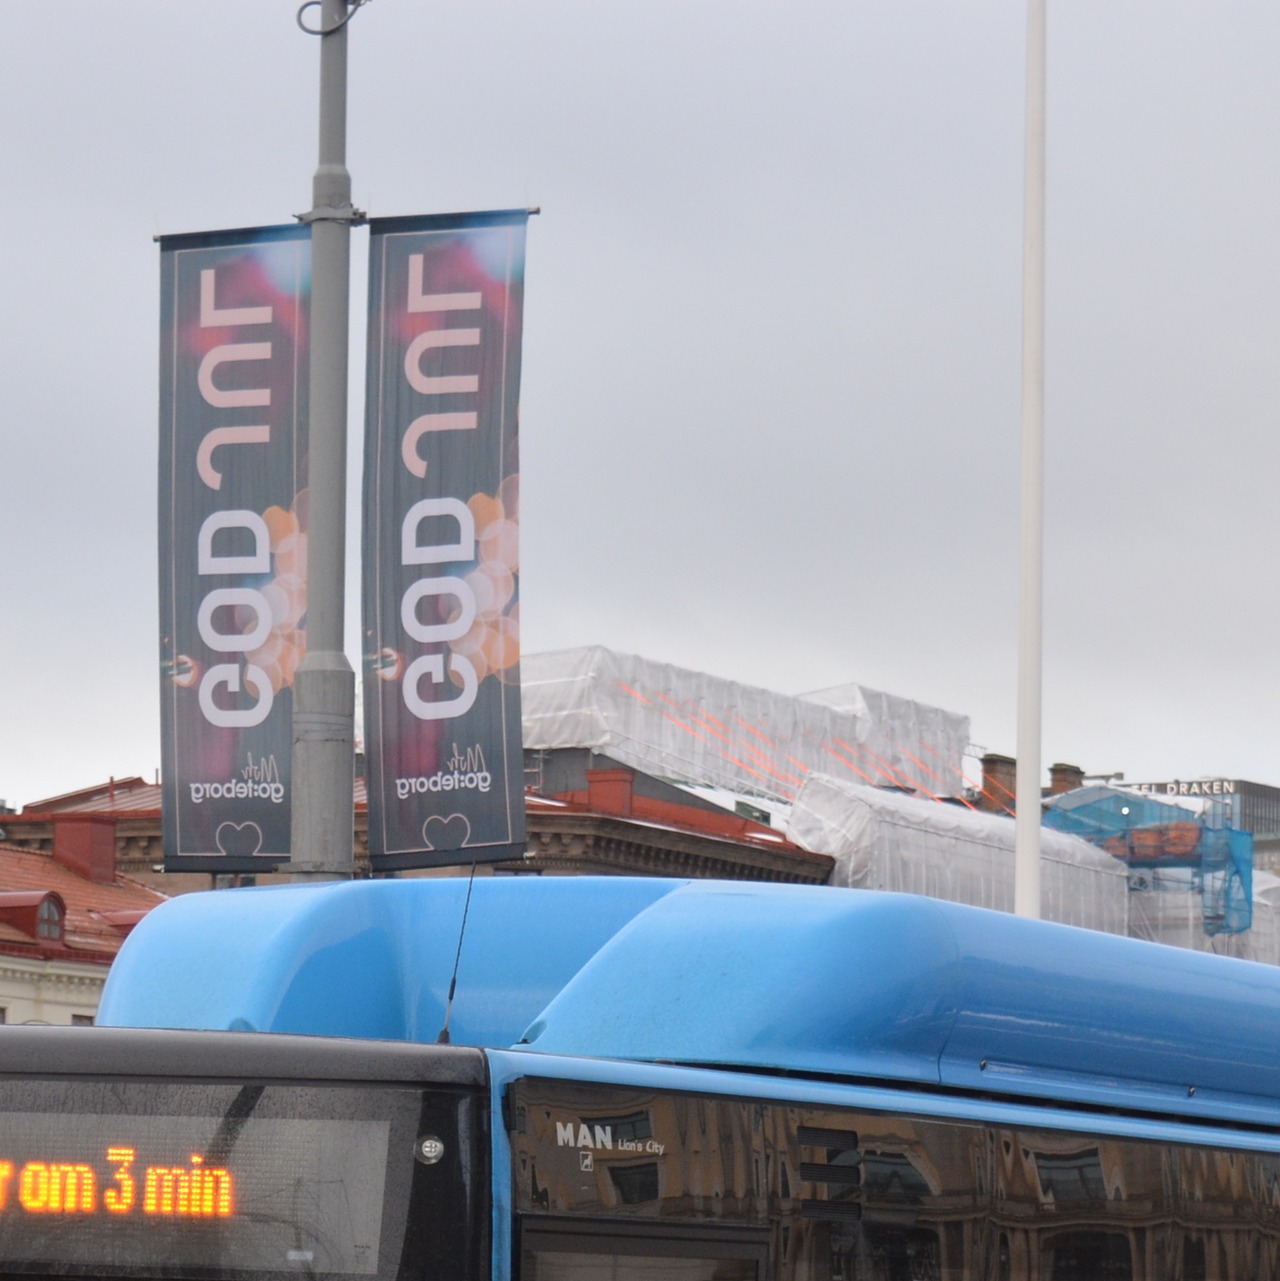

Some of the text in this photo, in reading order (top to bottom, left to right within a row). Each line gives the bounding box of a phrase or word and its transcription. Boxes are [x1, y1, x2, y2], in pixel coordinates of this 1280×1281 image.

[1166, 781, 1236, 796] DRAKEN
[556, 1121, 665, 1156] MAN Lion's City
[20, 1162, 95, 1213] om
[104, 1147, 135, 1211] 3
[144, 1153, 234, 1217] min
